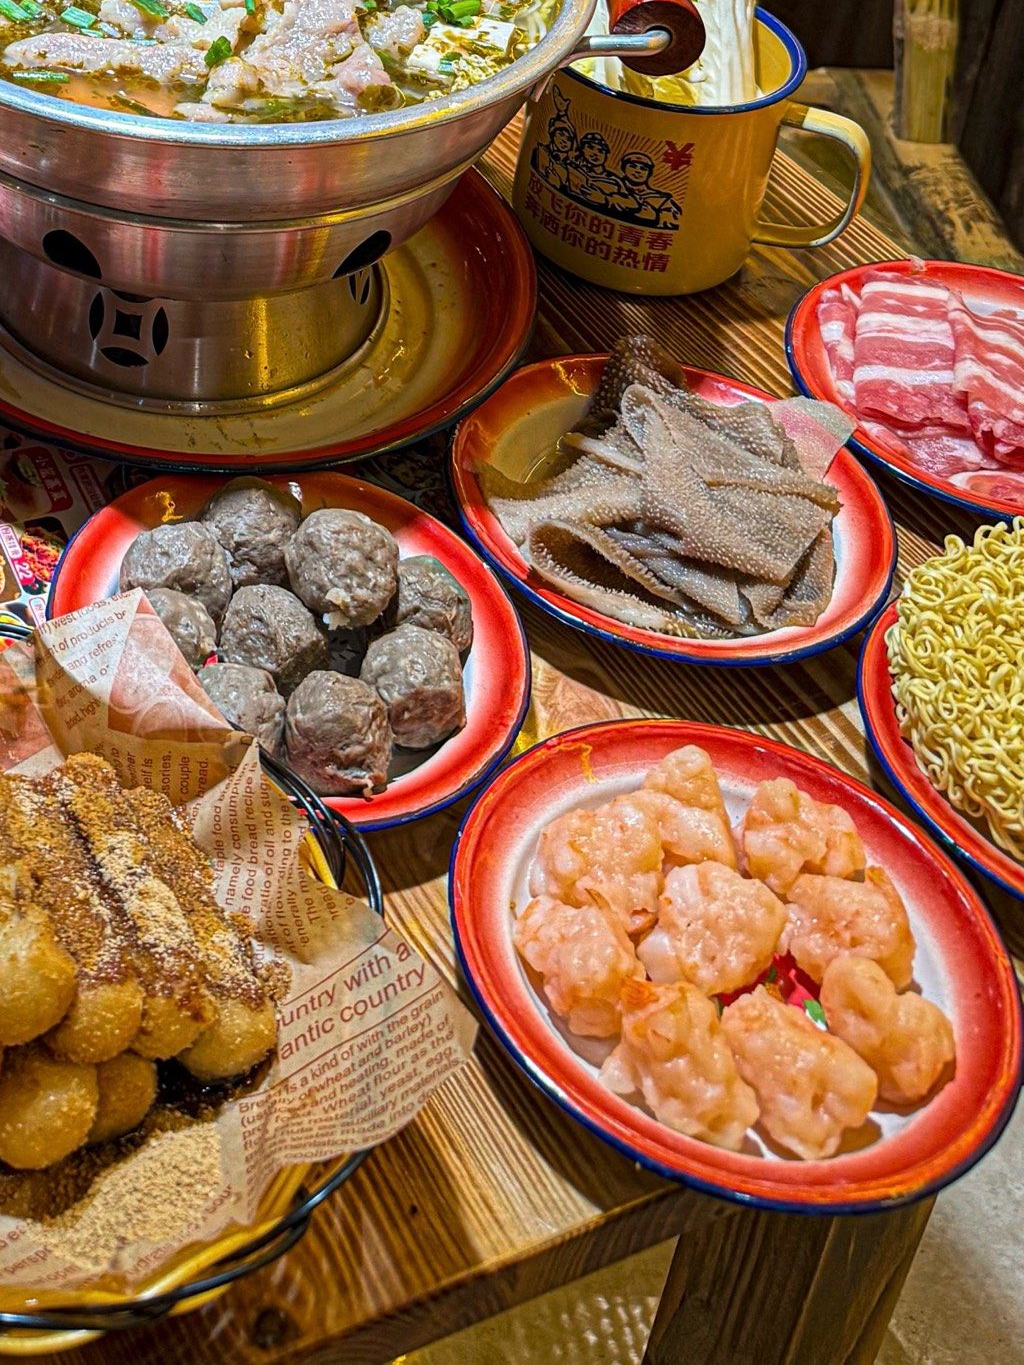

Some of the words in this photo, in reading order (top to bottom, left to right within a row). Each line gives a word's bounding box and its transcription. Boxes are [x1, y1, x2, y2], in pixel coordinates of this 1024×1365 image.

[528, 173, 674, 251] 放飞你的青春
[177, 754, 191, 796] couple
[228, 762, 250, 851] consumption
[244, 775, 256, 822] recipe
[279, 803, 293, 827] the
[211, 804, 223, 837] food
[260, 809, 276, 838] and
[282, 828, 294, 843] to
[244, 823, 259, 865] bread
[264, 838, 276, 859] oil
[224, 852, 244, 907] namely
[241, 867, 258, 902] food
[263, 860, 275, 877] of
[259, 879, 273, 914] ratio
[303, 897, 322, 926] The
[276, 983, 337, 1032] untry
[343, 953, 393, 993] with
[395, 941, 413, 964] a
[276, 1016, 336, 1062] antic
[339, 962, 426, 1024] country
[285, 1082, 299, 1096] is
[300, 1076, 310, 1087] a
[309, 1053, 339, 1082] kind
[339, 1045, 356, 1062] of
[356, 1029, 386, 1052] with
[386, 1015, 410, 1035] the
[409, 990, 445, 1021] grain
[314, 1062, 358, 1095] wheat
[357, 1044, 383, 1069] and
[384, 1012, 433, 1050] barley)
[394, 1030, 435, 1058] made
[435, 1011, 452, 1034] of
[321, 1081, 372, 1115] Wheat
[372, 1060, 408, 1088] flour
[409, 1047, 428, 1065] as
[429, 1029, 456, 1051] the
